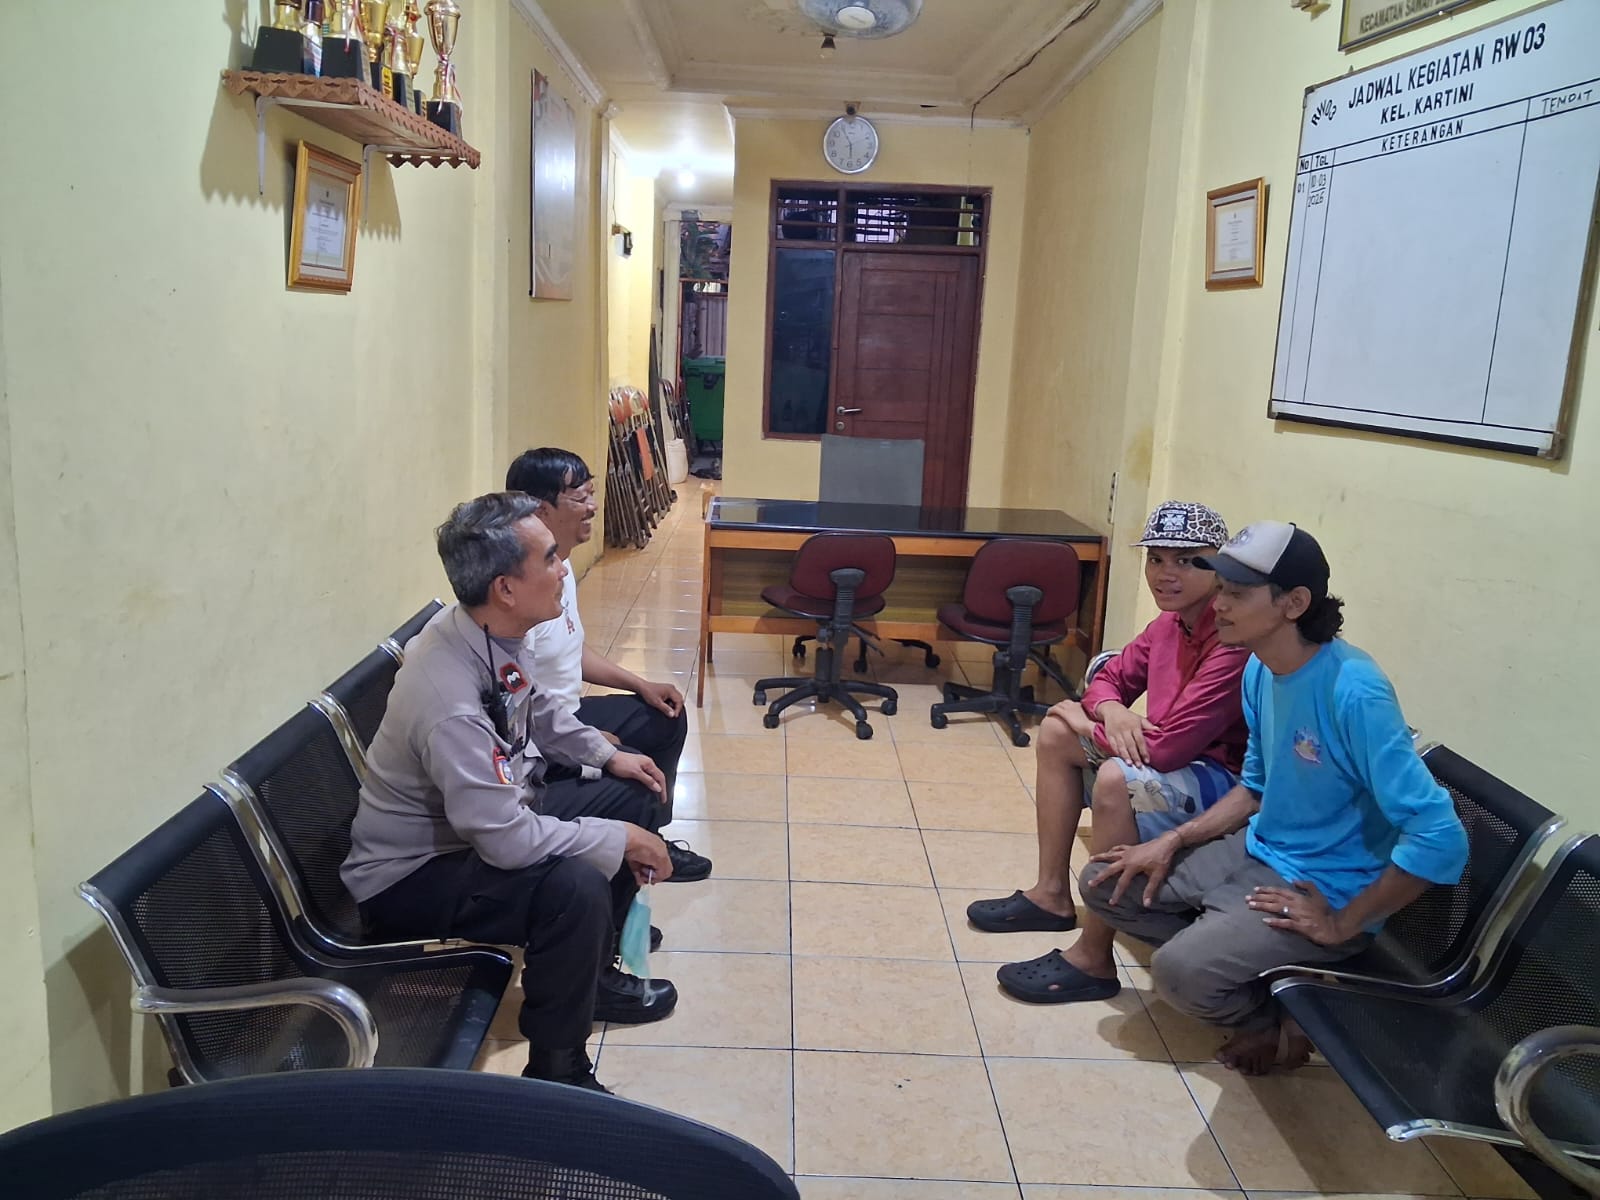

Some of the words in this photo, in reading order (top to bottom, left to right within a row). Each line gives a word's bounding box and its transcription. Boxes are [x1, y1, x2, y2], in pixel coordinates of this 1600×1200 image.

[1359, 5, 1404, 34] KECAMATAN
[1348, 72, 1402, 109] JADWAL
[1407, 44, 1485, 91] KEGIATAN
[1380, 93, 1411, 125] KEL.
[1414, 82, 1475, 116] KARTINI
[1381, 119, 1463, 152] KETERANGAN
